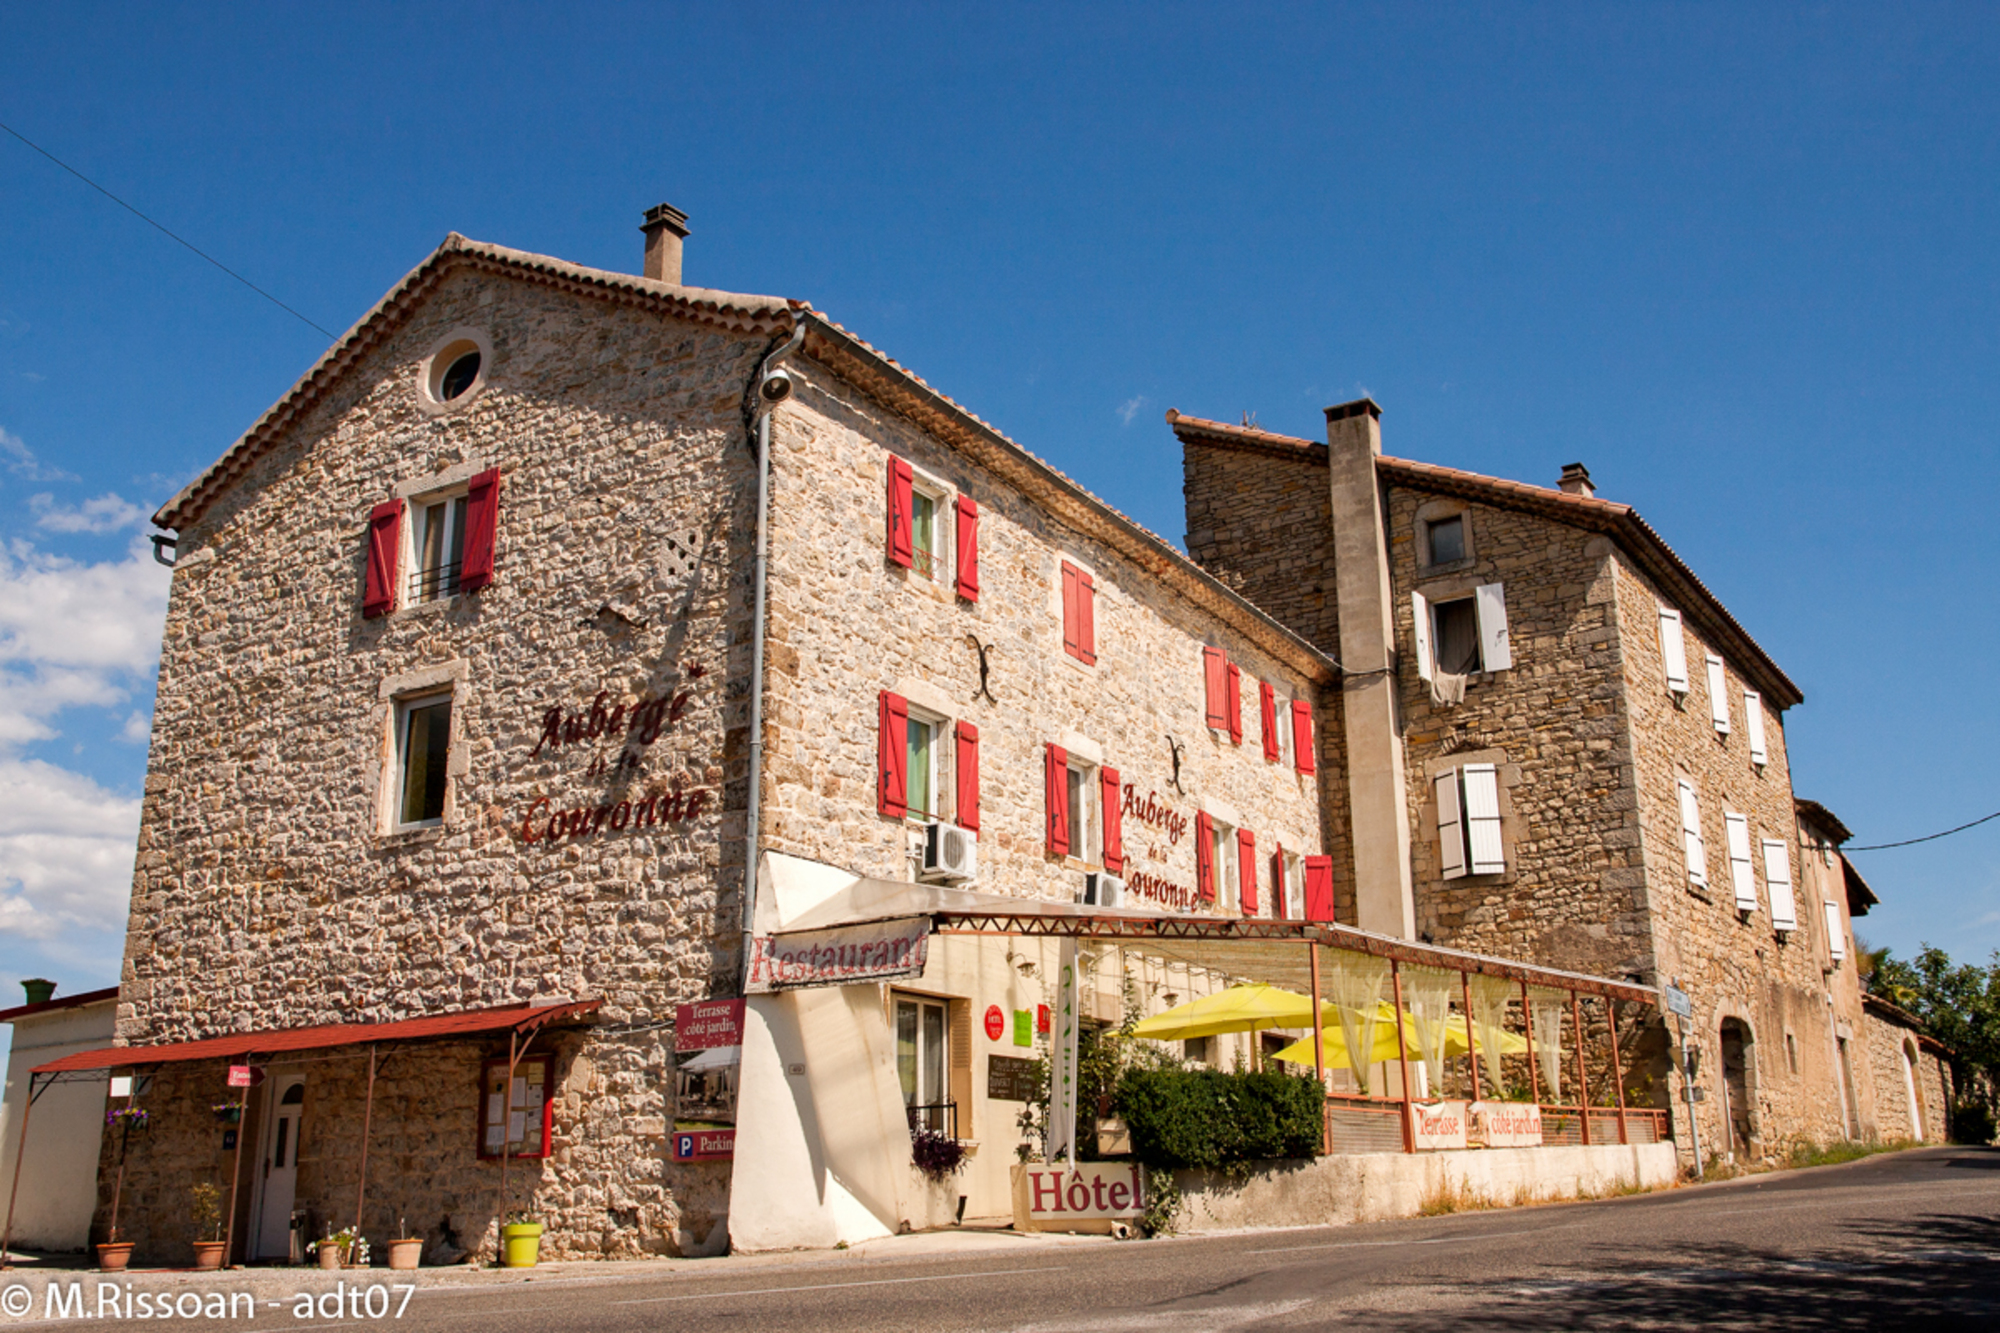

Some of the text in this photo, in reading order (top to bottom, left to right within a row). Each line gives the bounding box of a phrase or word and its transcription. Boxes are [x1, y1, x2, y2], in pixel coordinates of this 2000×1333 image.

[528, 690, 688, 756] Auberge
[522, 788, 707, 844] Couronne
[1121, 783, 1188, 846] Auberge
[750, 929, 928, 983] Restaurant
[691, 1005, 731, 1019] Terrasse
[706, 1018, 736, 1038] jardin
[1414, 1107, 1460, 1136] Terrasse
[1490, 1108, 1541, 1143] côté jardin
[681, 1134, 735, 1156] P Parkin
[1027, 1165, 1145, 1213] Hôtel
